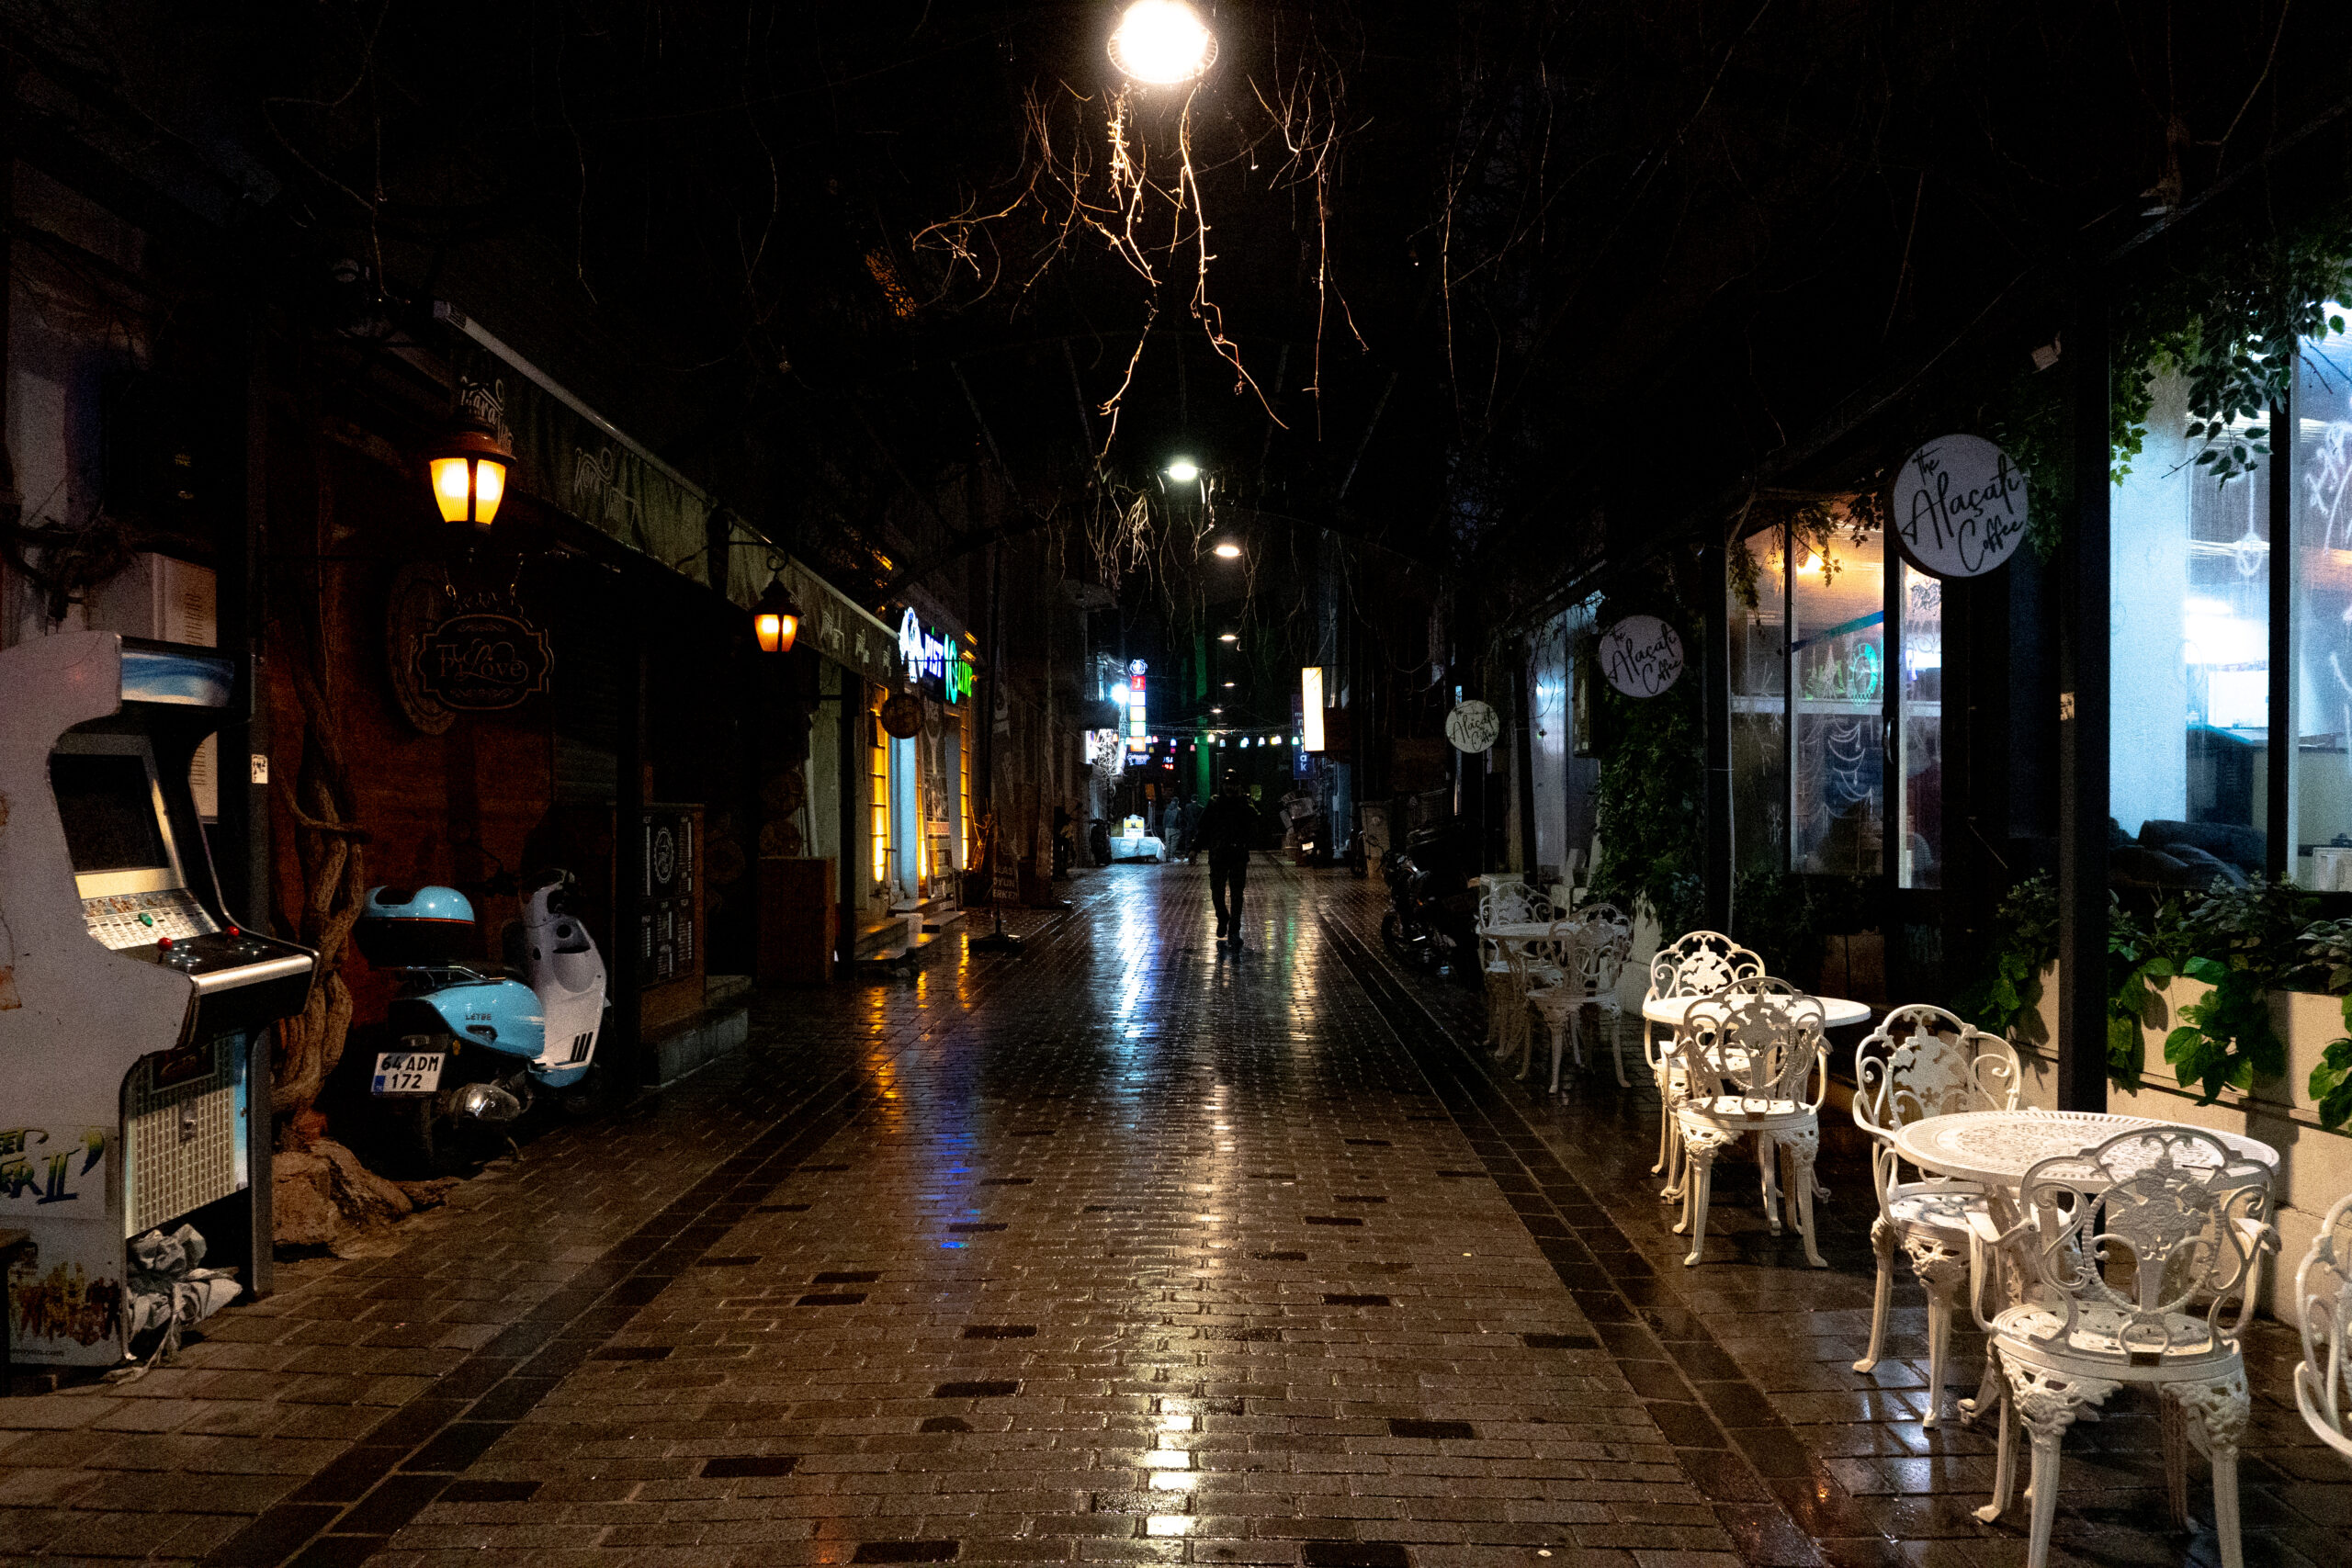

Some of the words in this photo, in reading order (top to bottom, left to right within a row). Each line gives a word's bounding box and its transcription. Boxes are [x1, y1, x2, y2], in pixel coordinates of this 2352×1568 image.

[1912, 446, 1943, 486] The
[1958, 514, 2024, 573] Coffee
[380, 1055, 402, 1071] 64
[405, 1055, 439, 1072] ADM
[391, 1073, 423, 1089] 172
